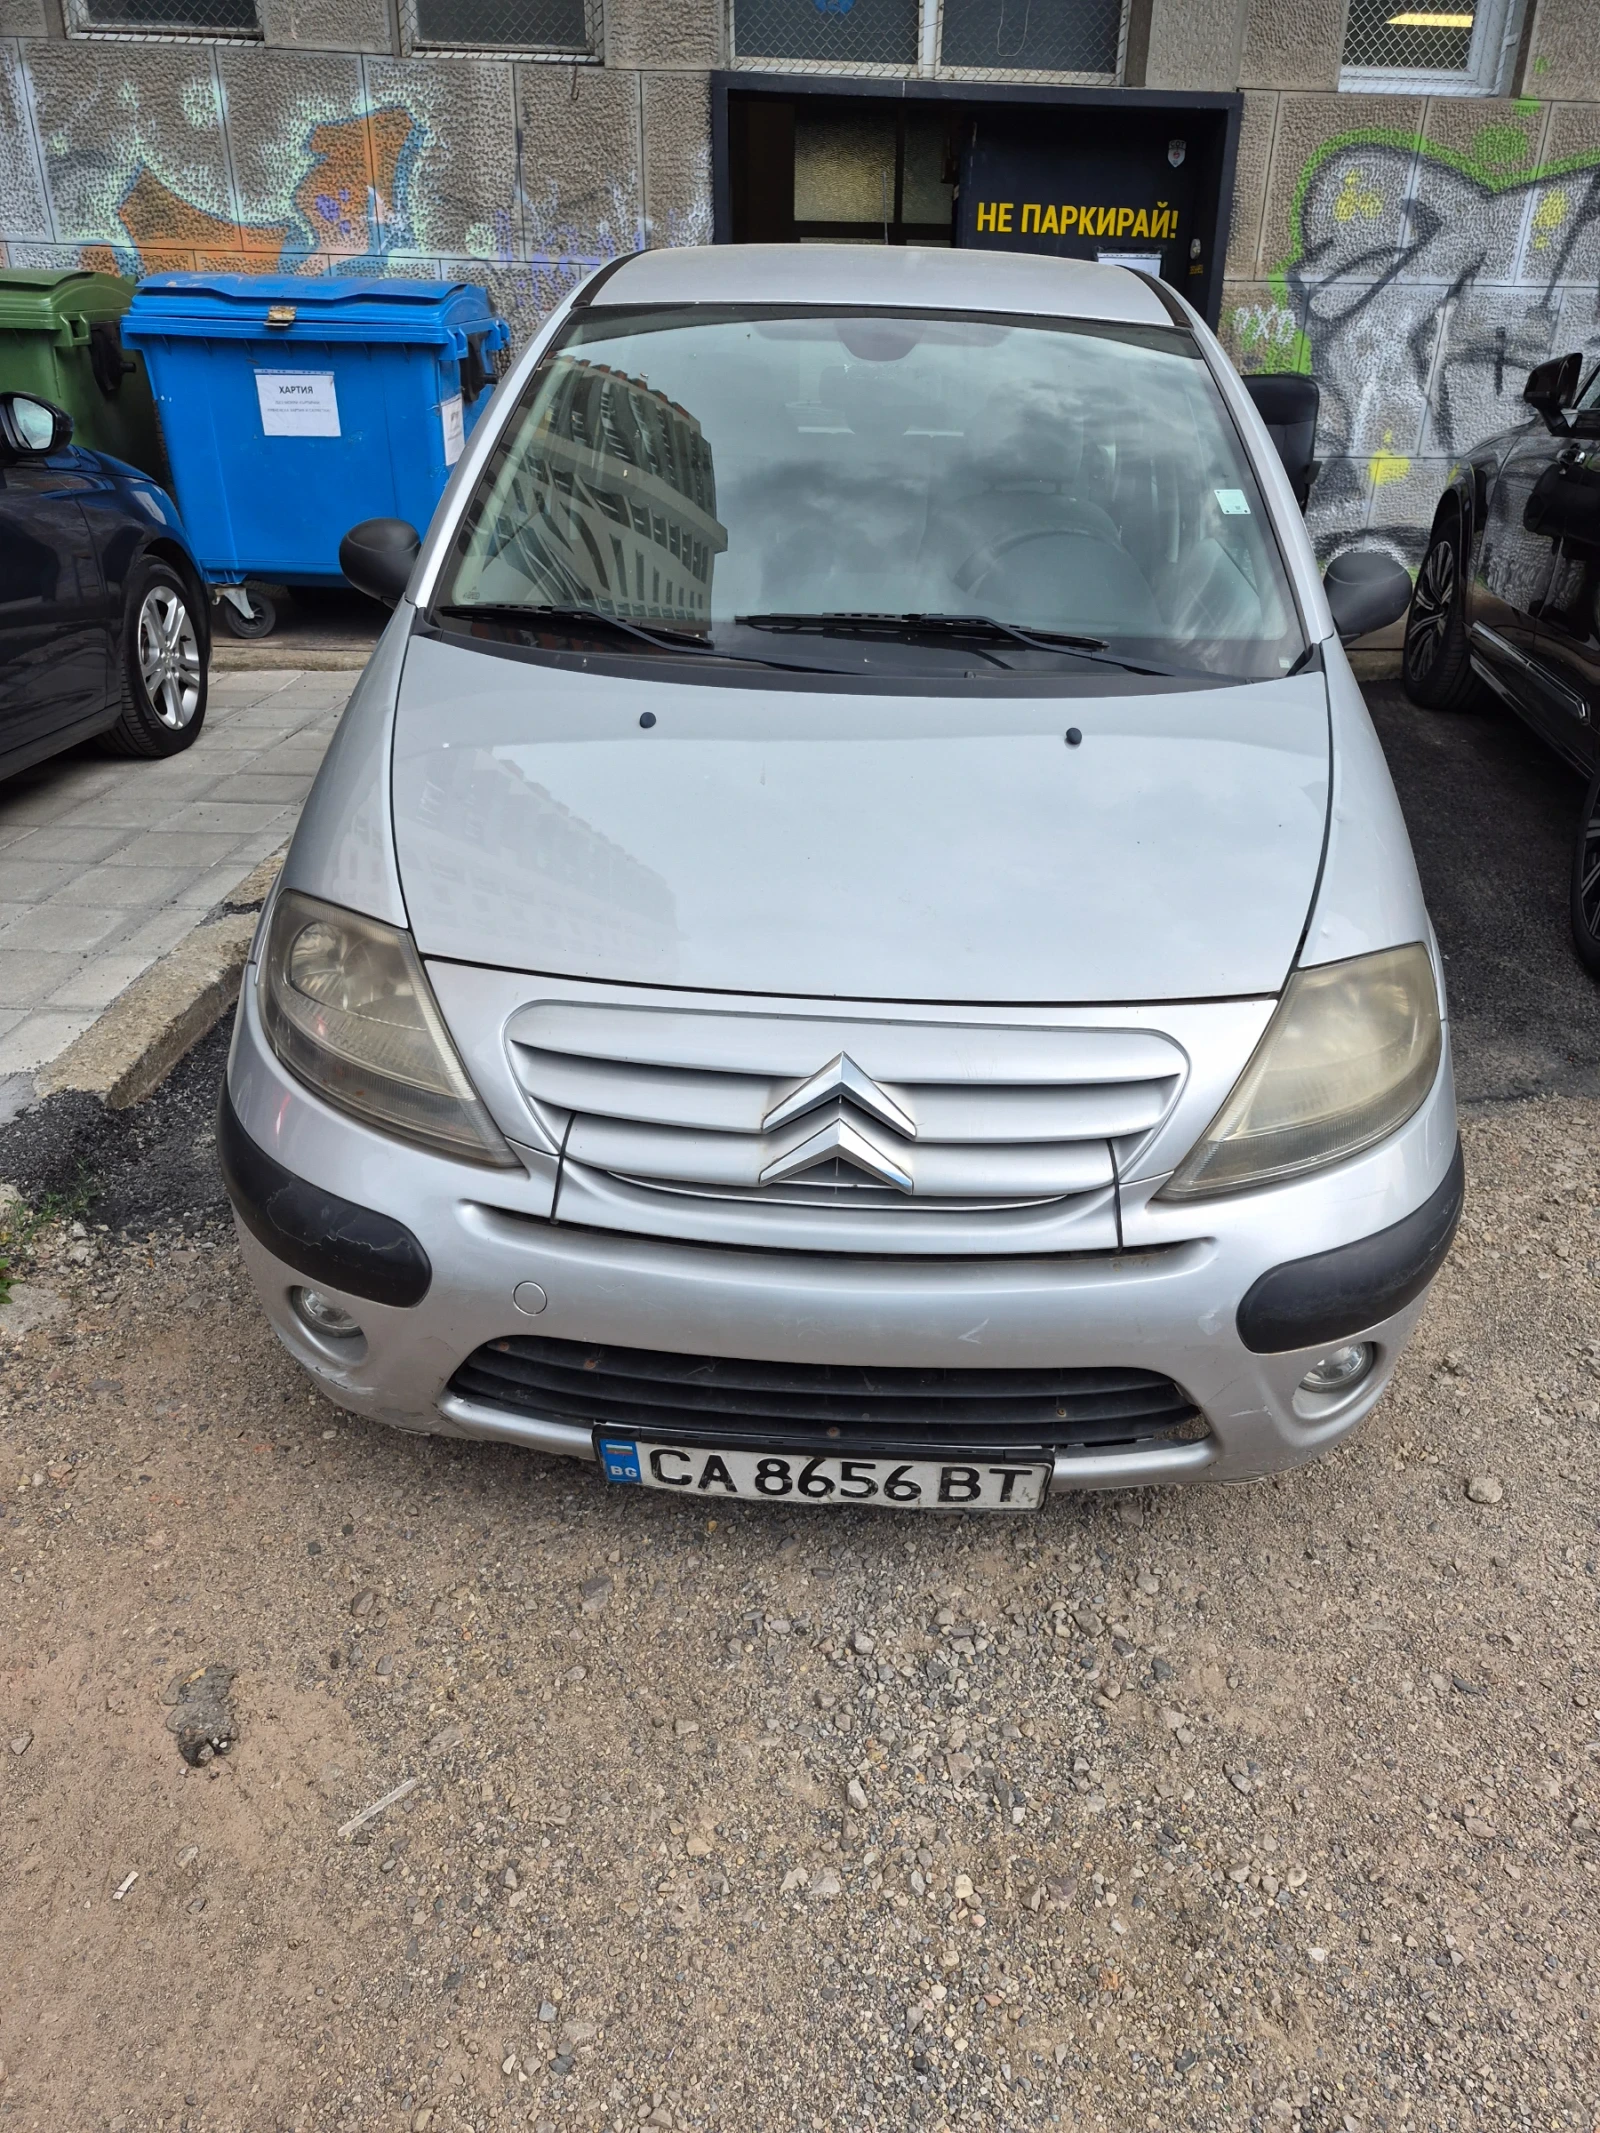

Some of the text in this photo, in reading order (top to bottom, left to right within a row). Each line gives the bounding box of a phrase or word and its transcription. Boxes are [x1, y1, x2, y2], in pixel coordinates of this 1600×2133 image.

[976, 201, 1179, 239] НЕ ПАРКИРАЙ!
[279, 386, 313, 394] ХАРТИЯ
[610, 1465, 638, 1477] BG
[649, 1448, 1033, 1503] CA 8656 BT
